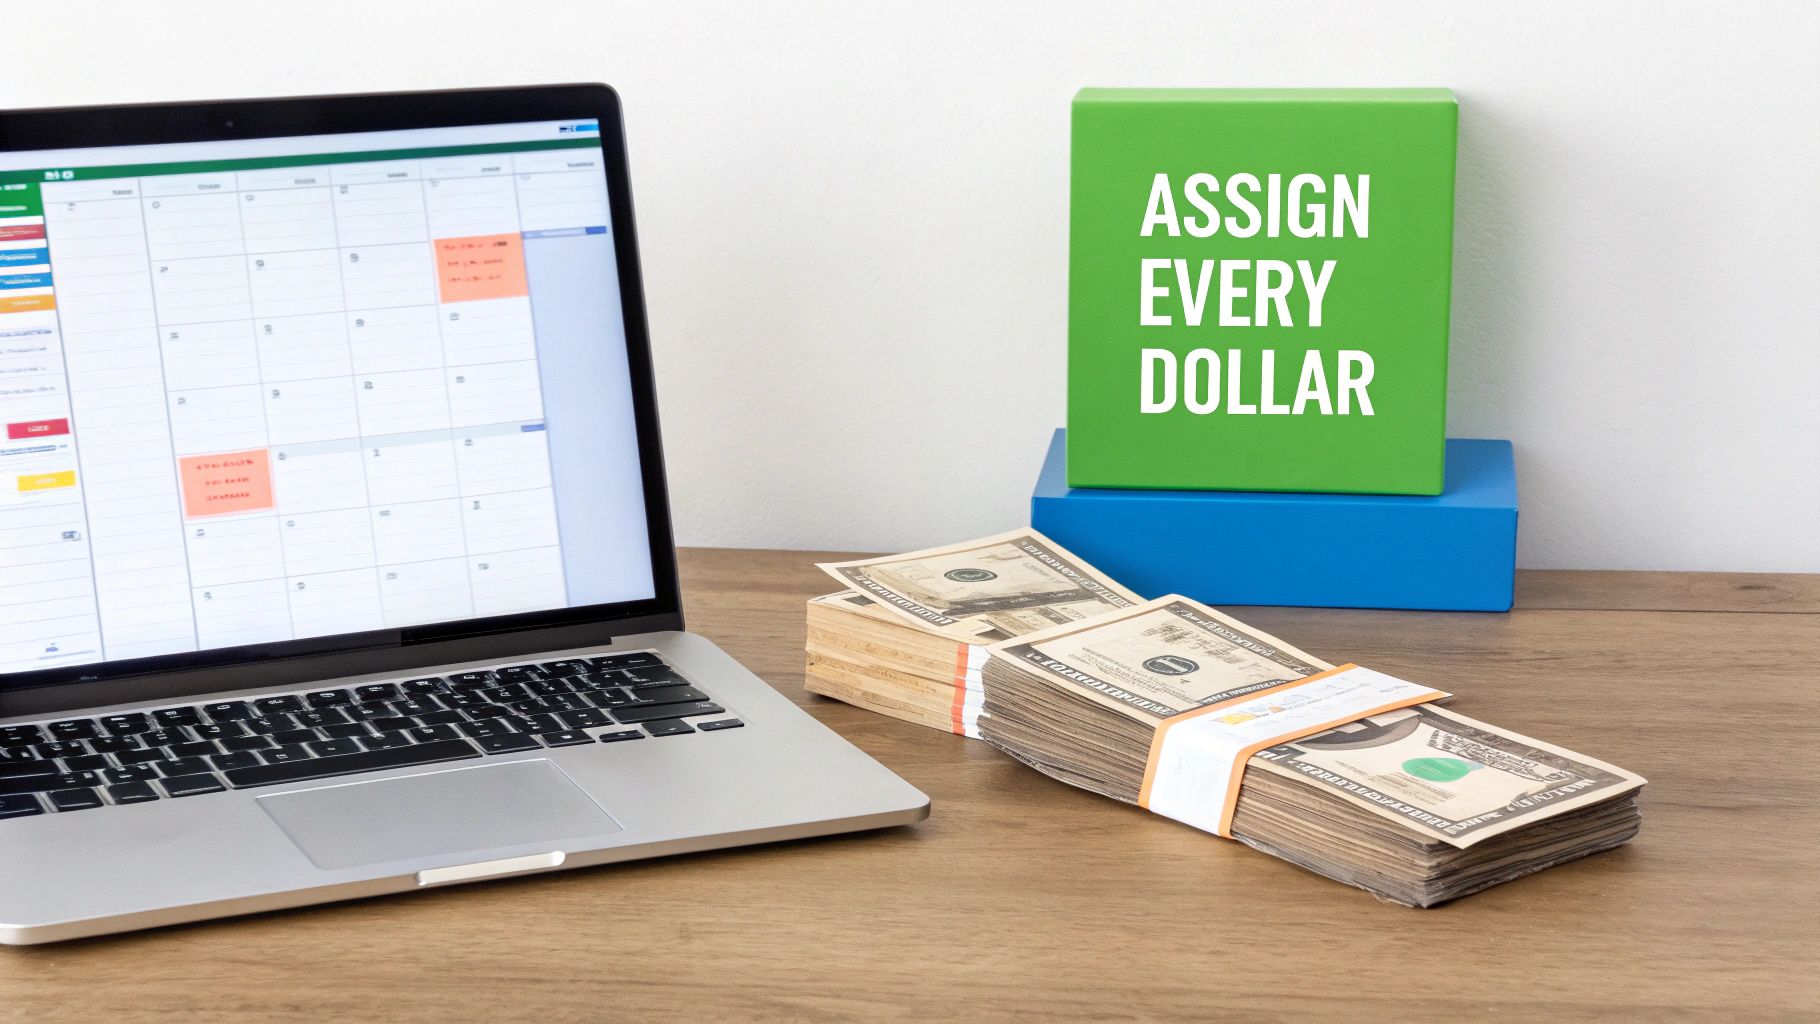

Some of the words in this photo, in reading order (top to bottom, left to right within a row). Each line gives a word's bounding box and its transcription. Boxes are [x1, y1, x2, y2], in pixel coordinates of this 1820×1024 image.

[1140, 172, 1371, 240] ASSIGN
[1139, 258, 1338, 328] EVERY
[1139, 347, 1376, 416] DOLLAR
